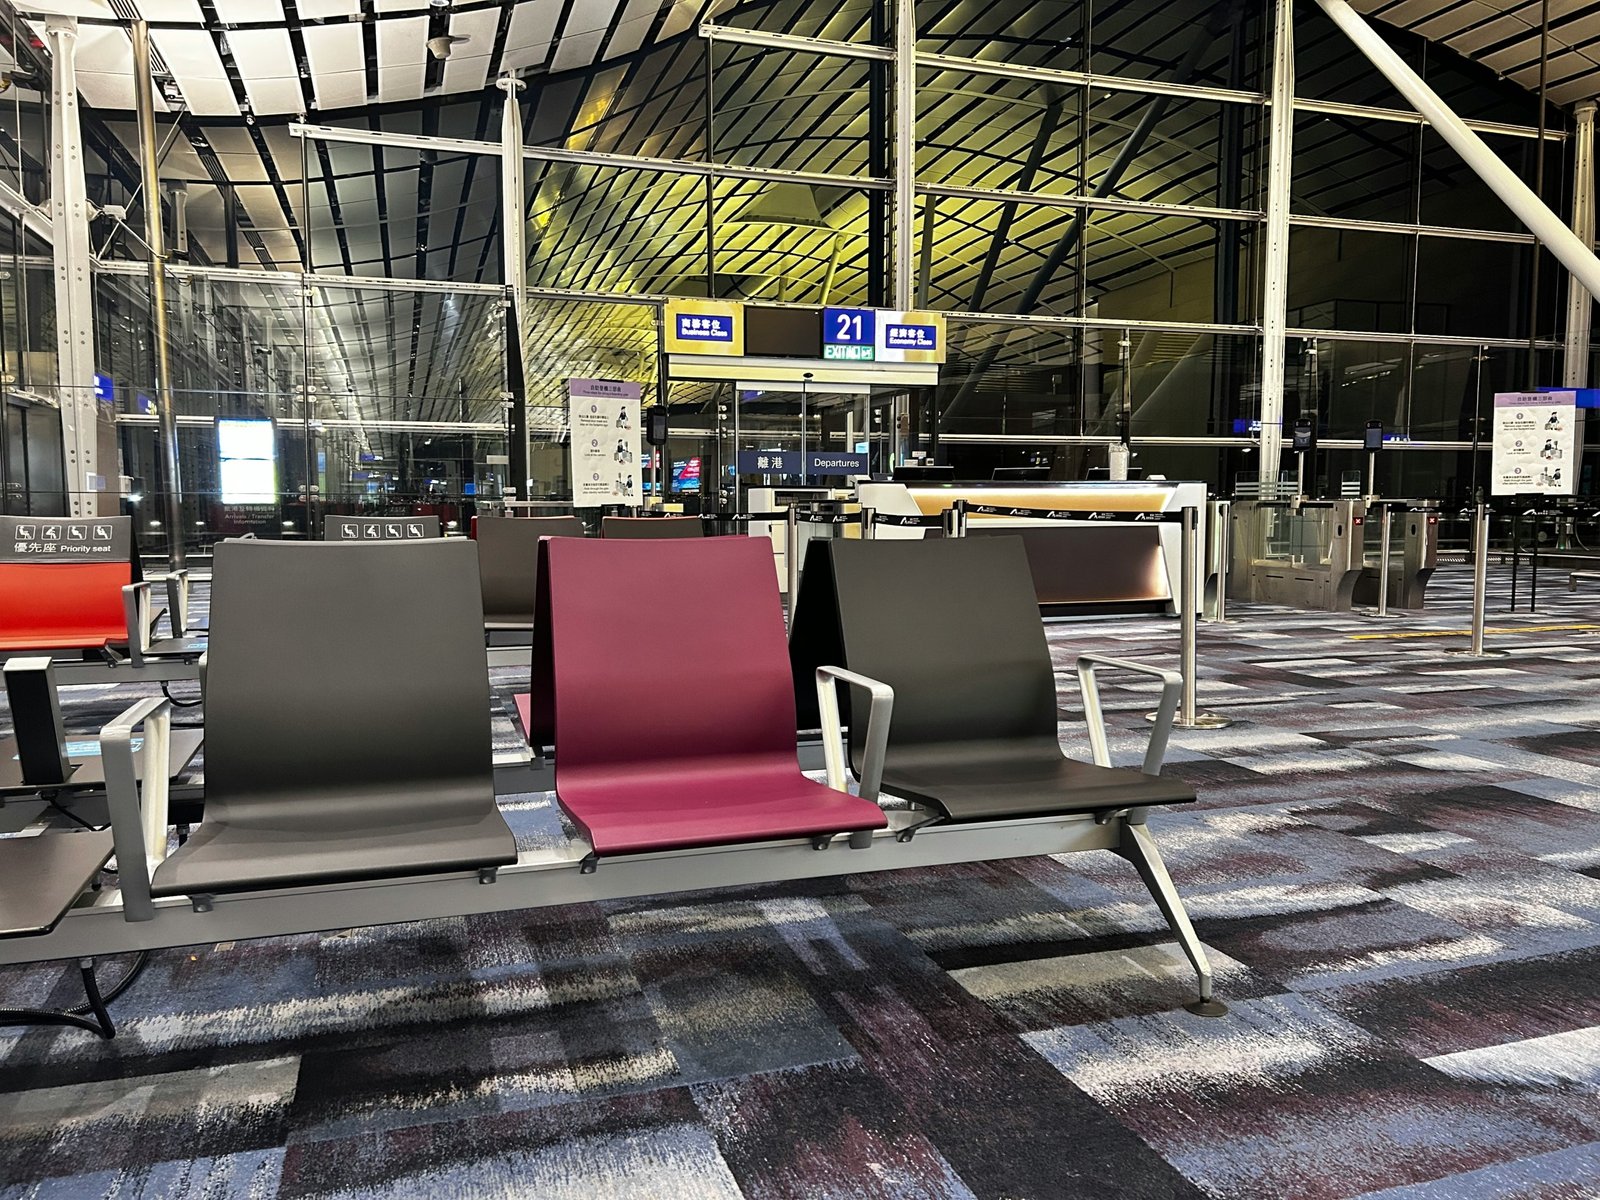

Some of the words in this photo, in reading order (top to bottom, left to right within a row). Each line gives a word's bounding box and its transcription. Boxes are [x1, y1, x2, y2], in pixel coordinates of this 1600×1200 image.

[681, 327, 710, 336] Business
[711, 329, 728, 337] Class
[836, 314, 862, 340] 21
[889, 337, 916, 346] Economy
[917, 338, 933, 346] Class
[825, 345, 846, 358] EXIT
[757, 456, 783, 469] 離港
[814, 458, 860, 468] Departures
[14, 542, 57, 553] 優先座
[60, 545, 91, 554] Priority
